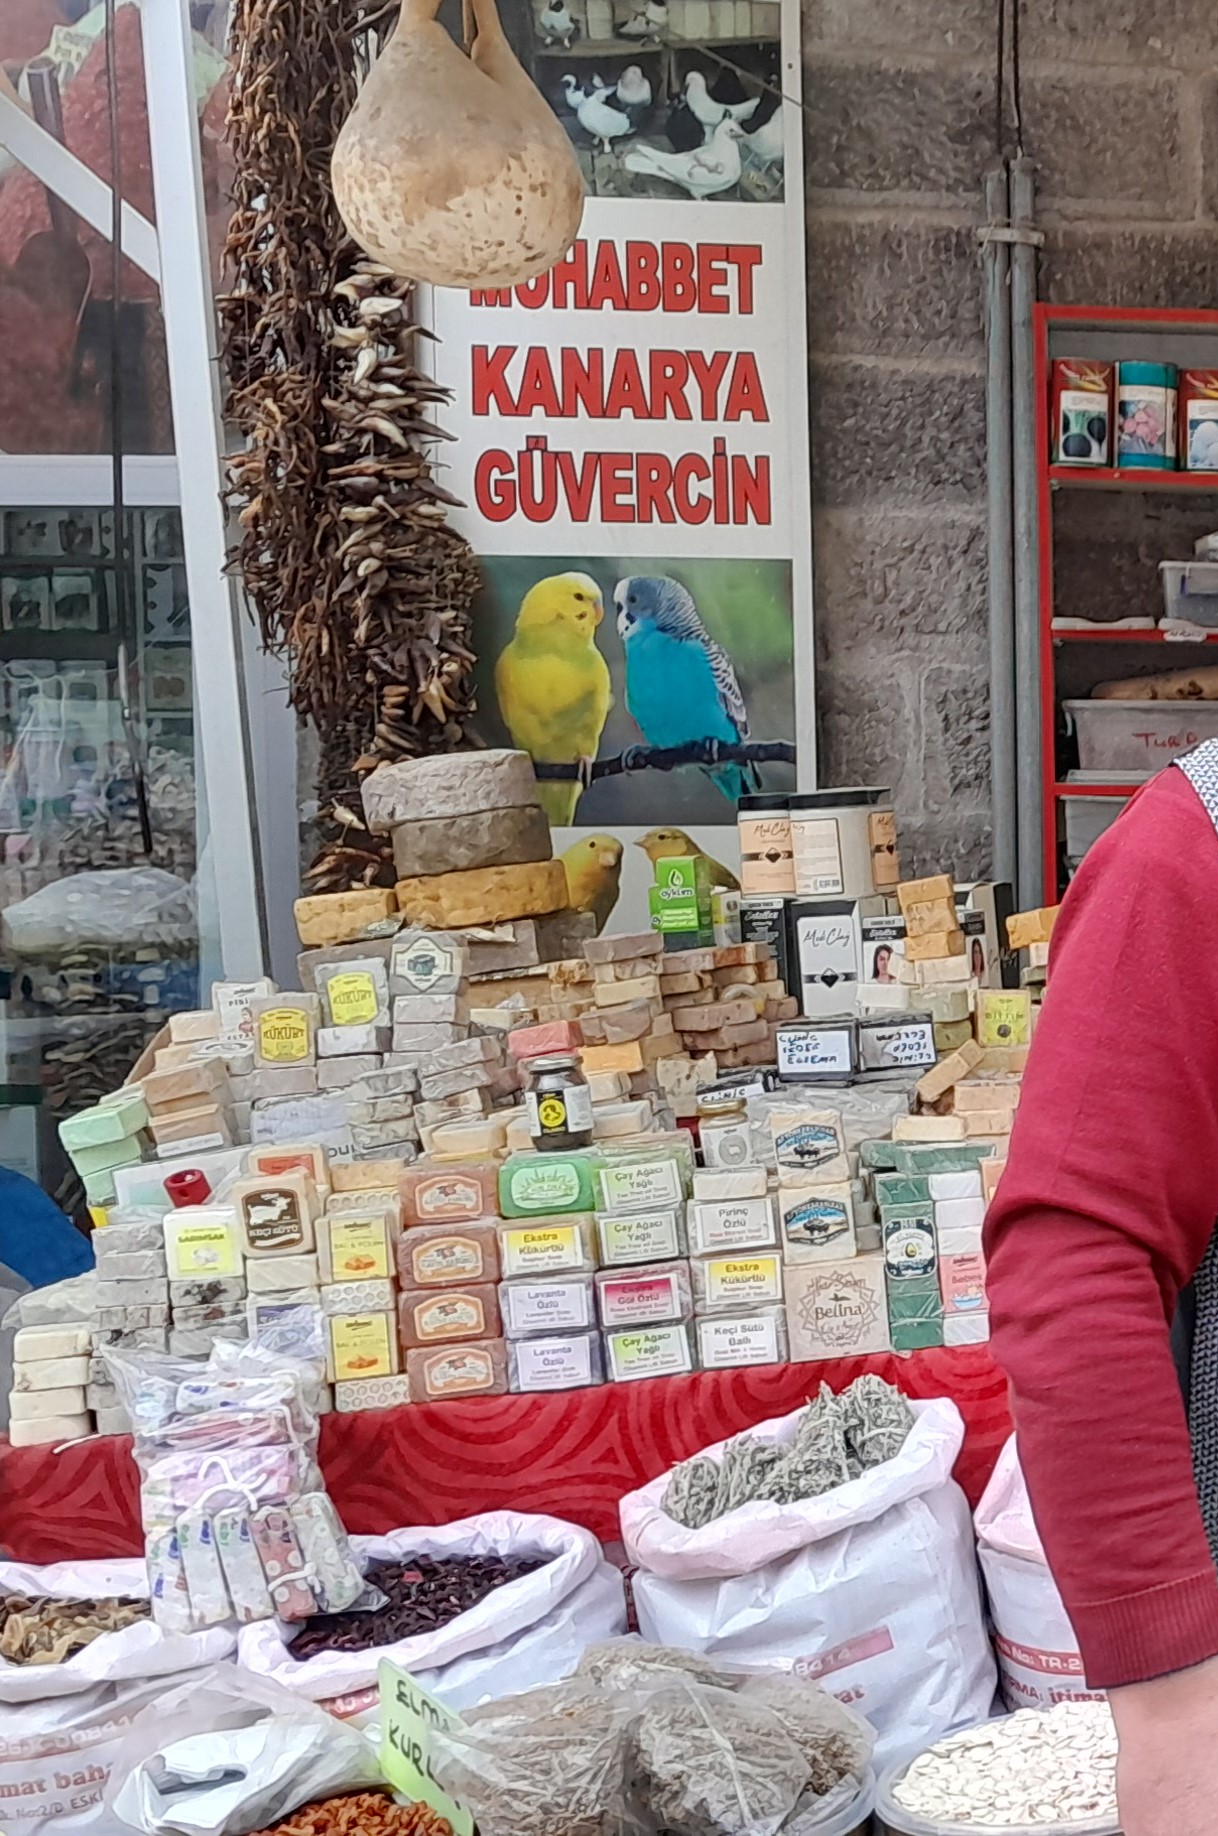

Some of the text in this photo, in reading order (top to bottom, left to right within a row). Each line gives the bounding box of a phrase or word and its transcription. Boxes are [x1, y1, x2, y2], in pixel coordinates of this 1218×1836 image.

[471, 345, 769, 423] KANARYA
[475, 436, 772, 526] GÜVERCİN
[263, 1024, 305, 1040] KÜKÜRT
[523, 1233, 558, 1243] Ekstra
[725, 1263, 760, 1273] Ekstra
[527, 1289, 567, 1299] Lavanta
[815, 1303, 863, 1321] Belina
[533, 1346, 572, 1357] Lavanta
